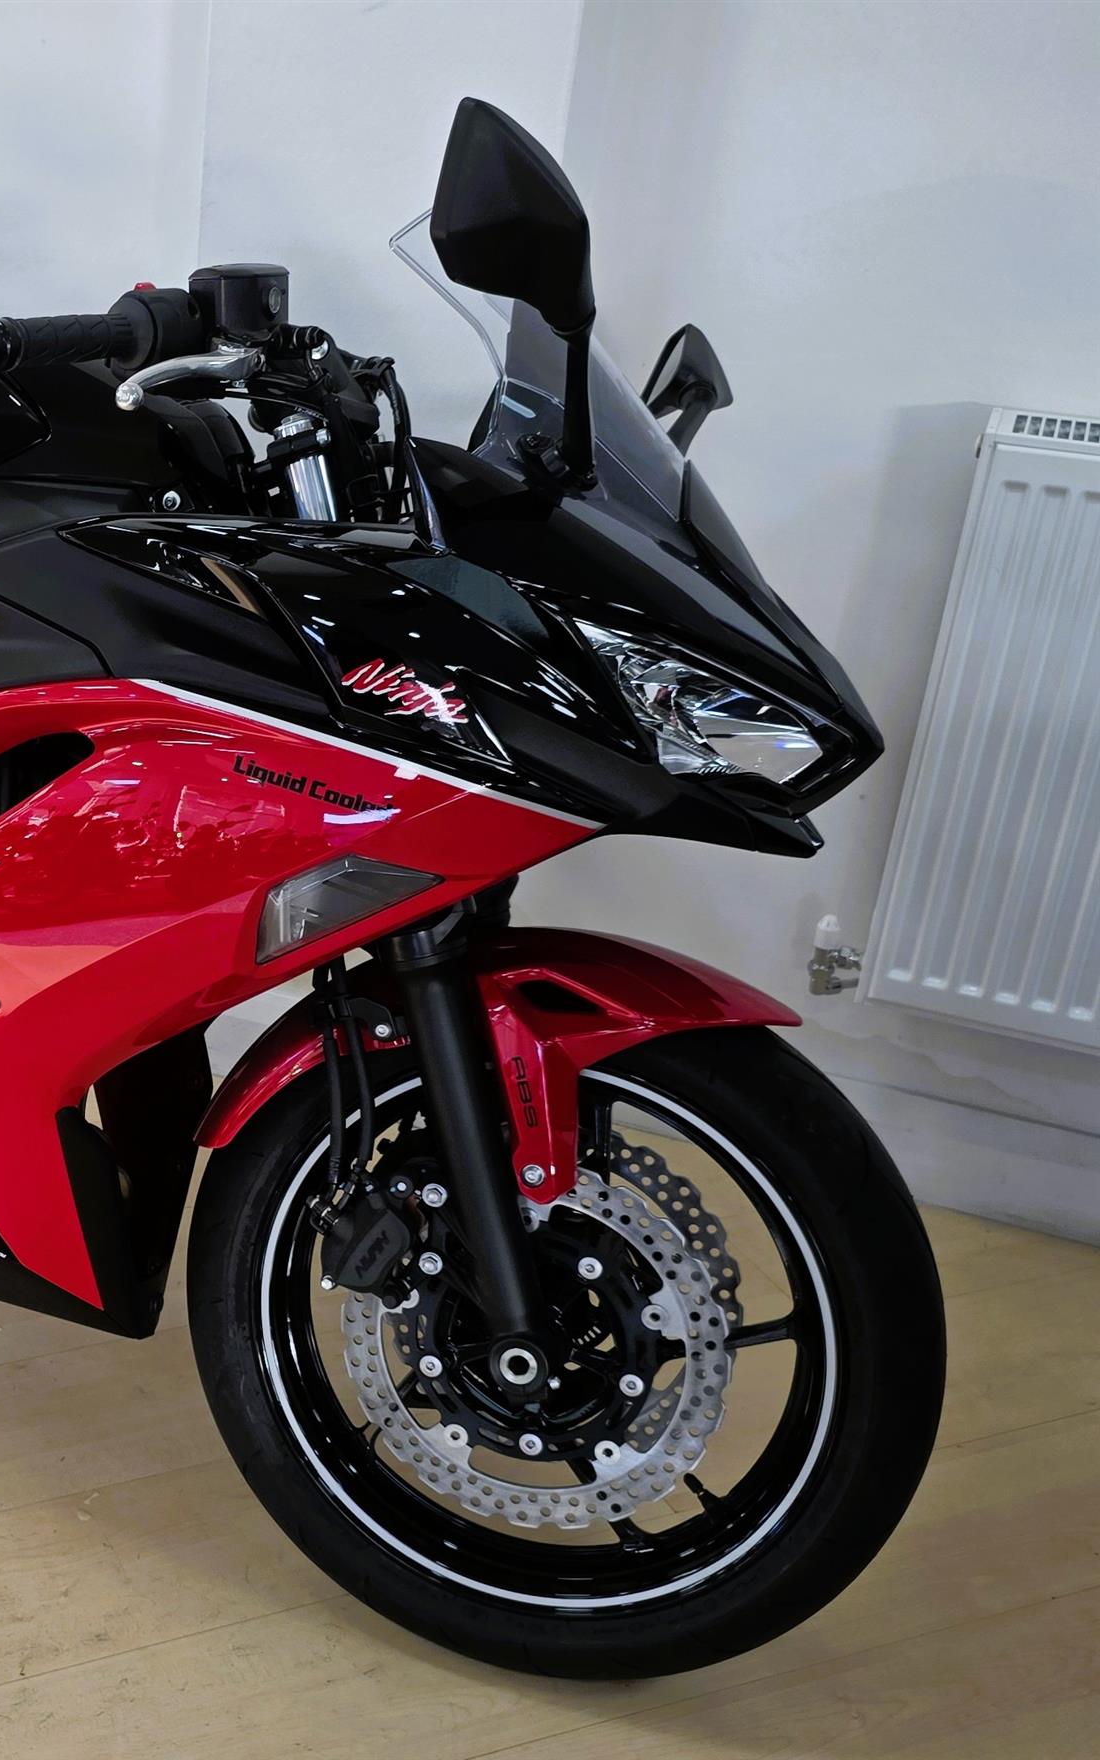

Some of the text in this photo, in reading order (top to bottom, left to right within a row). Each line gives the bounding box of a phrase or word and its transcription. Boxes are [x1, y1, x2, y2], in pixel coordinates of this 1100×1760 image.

[340, 658, 469, 724] Ninja
[233, 755, 307, 795] Liquid
[511, 1056, 538, 1128] ABS
